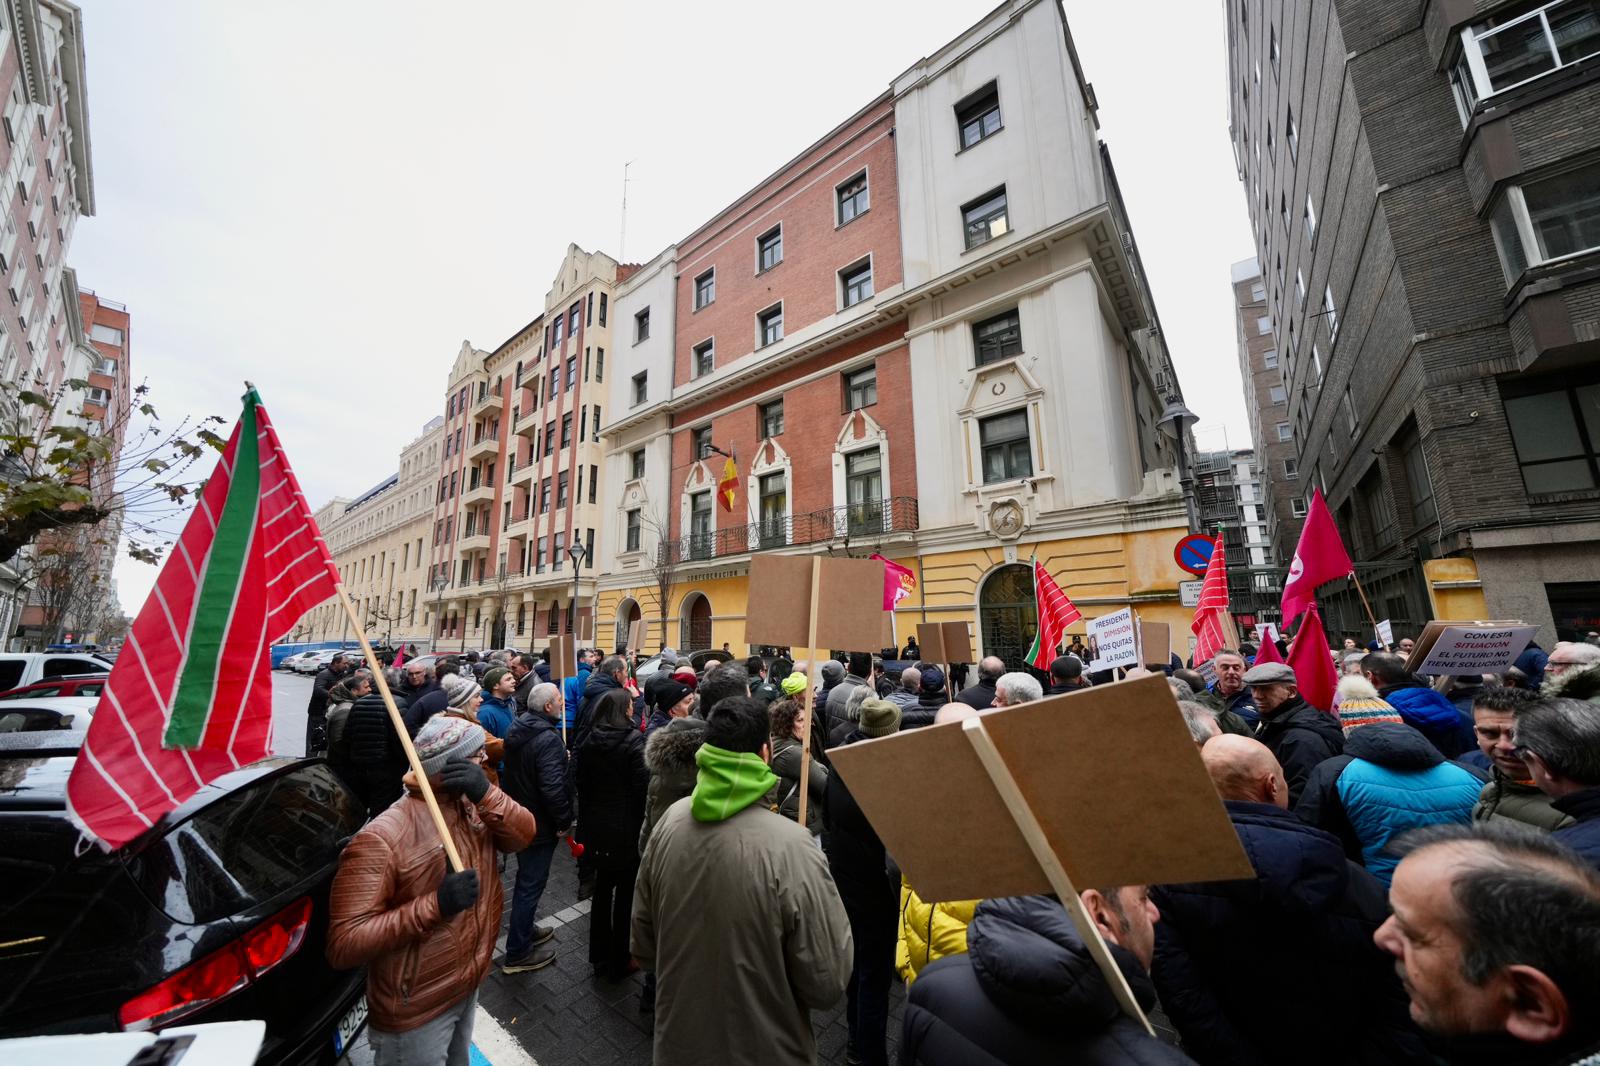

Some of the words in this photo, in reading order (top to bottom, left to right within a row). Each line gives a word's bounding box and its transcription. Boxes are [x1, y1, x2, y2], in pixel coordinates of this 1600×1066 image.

[1095, 612, 1130, 629] PRESIDENTA
[1490, 631, 1513, 639] ESTA
[1099, 642, 1112, 652] NOS
[1112, 637, 1133, 650] QUITAS
[1106, 654, 1114, 663] LA
[1114, 649, 1135, 661] RAZÓN
[1452, 651, 1493, 659] FUTURO
[1494, 650, 1510, 658] NO
[1426, 660, 1457, 668] TIENE
[1457, 659, 1509, 668] SOLUCIÓN
